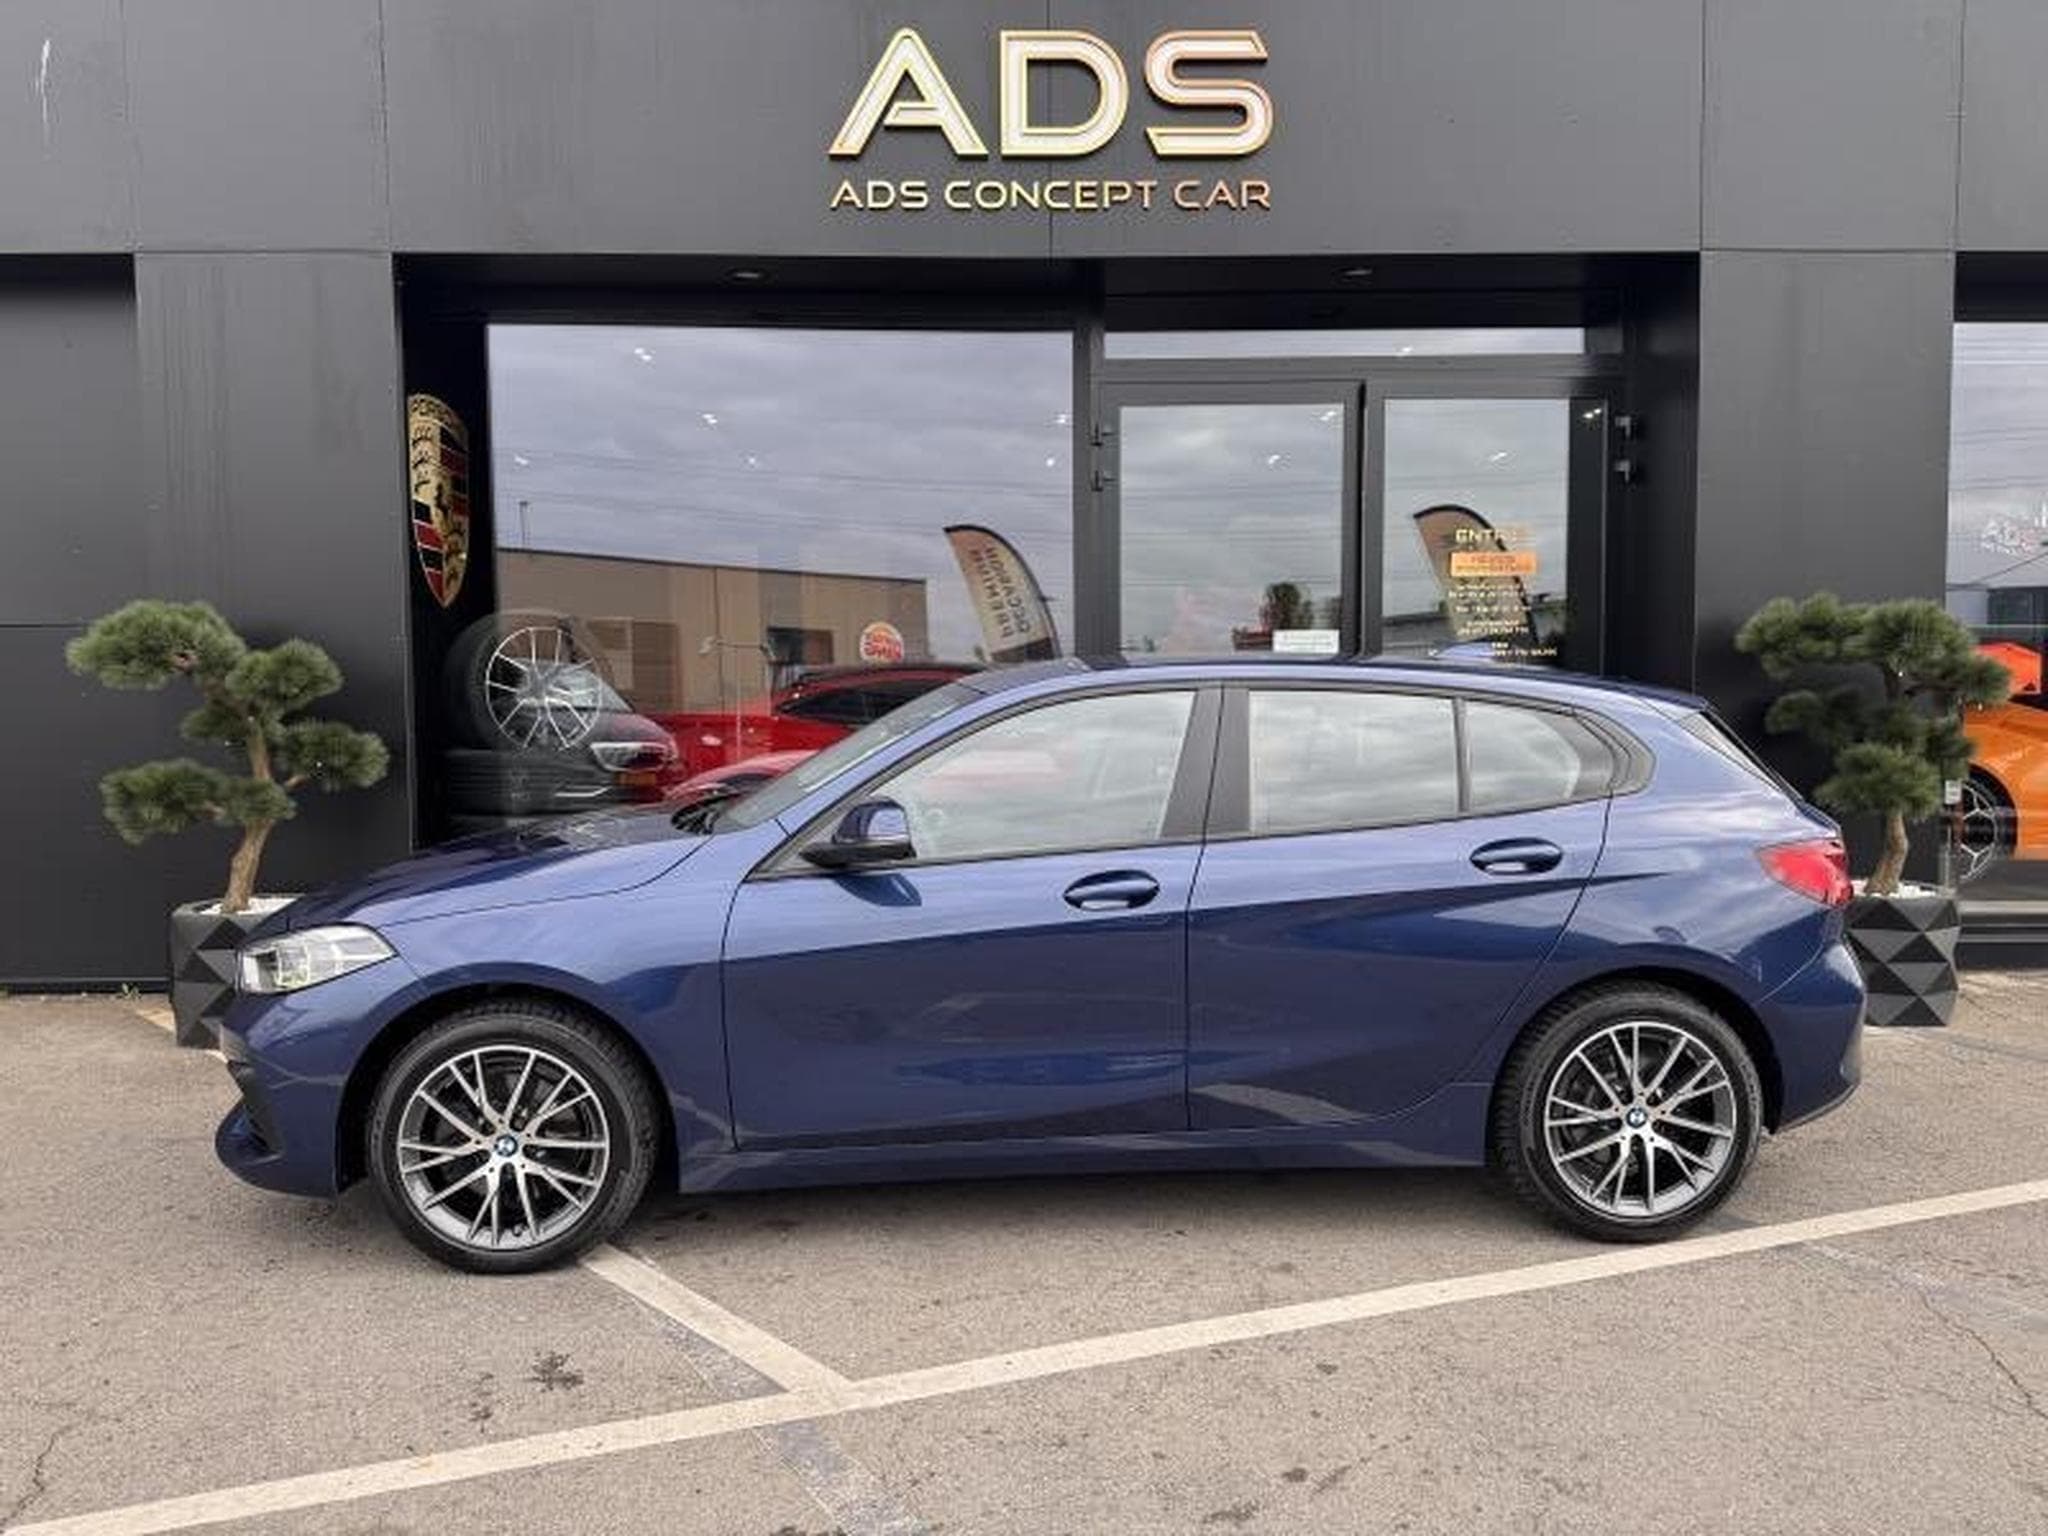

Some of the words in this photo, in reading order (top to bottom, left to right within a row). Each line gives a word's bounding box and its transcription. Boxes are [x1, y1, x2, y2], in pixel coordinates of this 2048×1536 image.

[829, 27, 1274, 157] ADS
[830, 180, 928, 210] ADS
[944, 180, 1158, 210] CONCEPT
[1173, 180, 1271, 210] CAR
